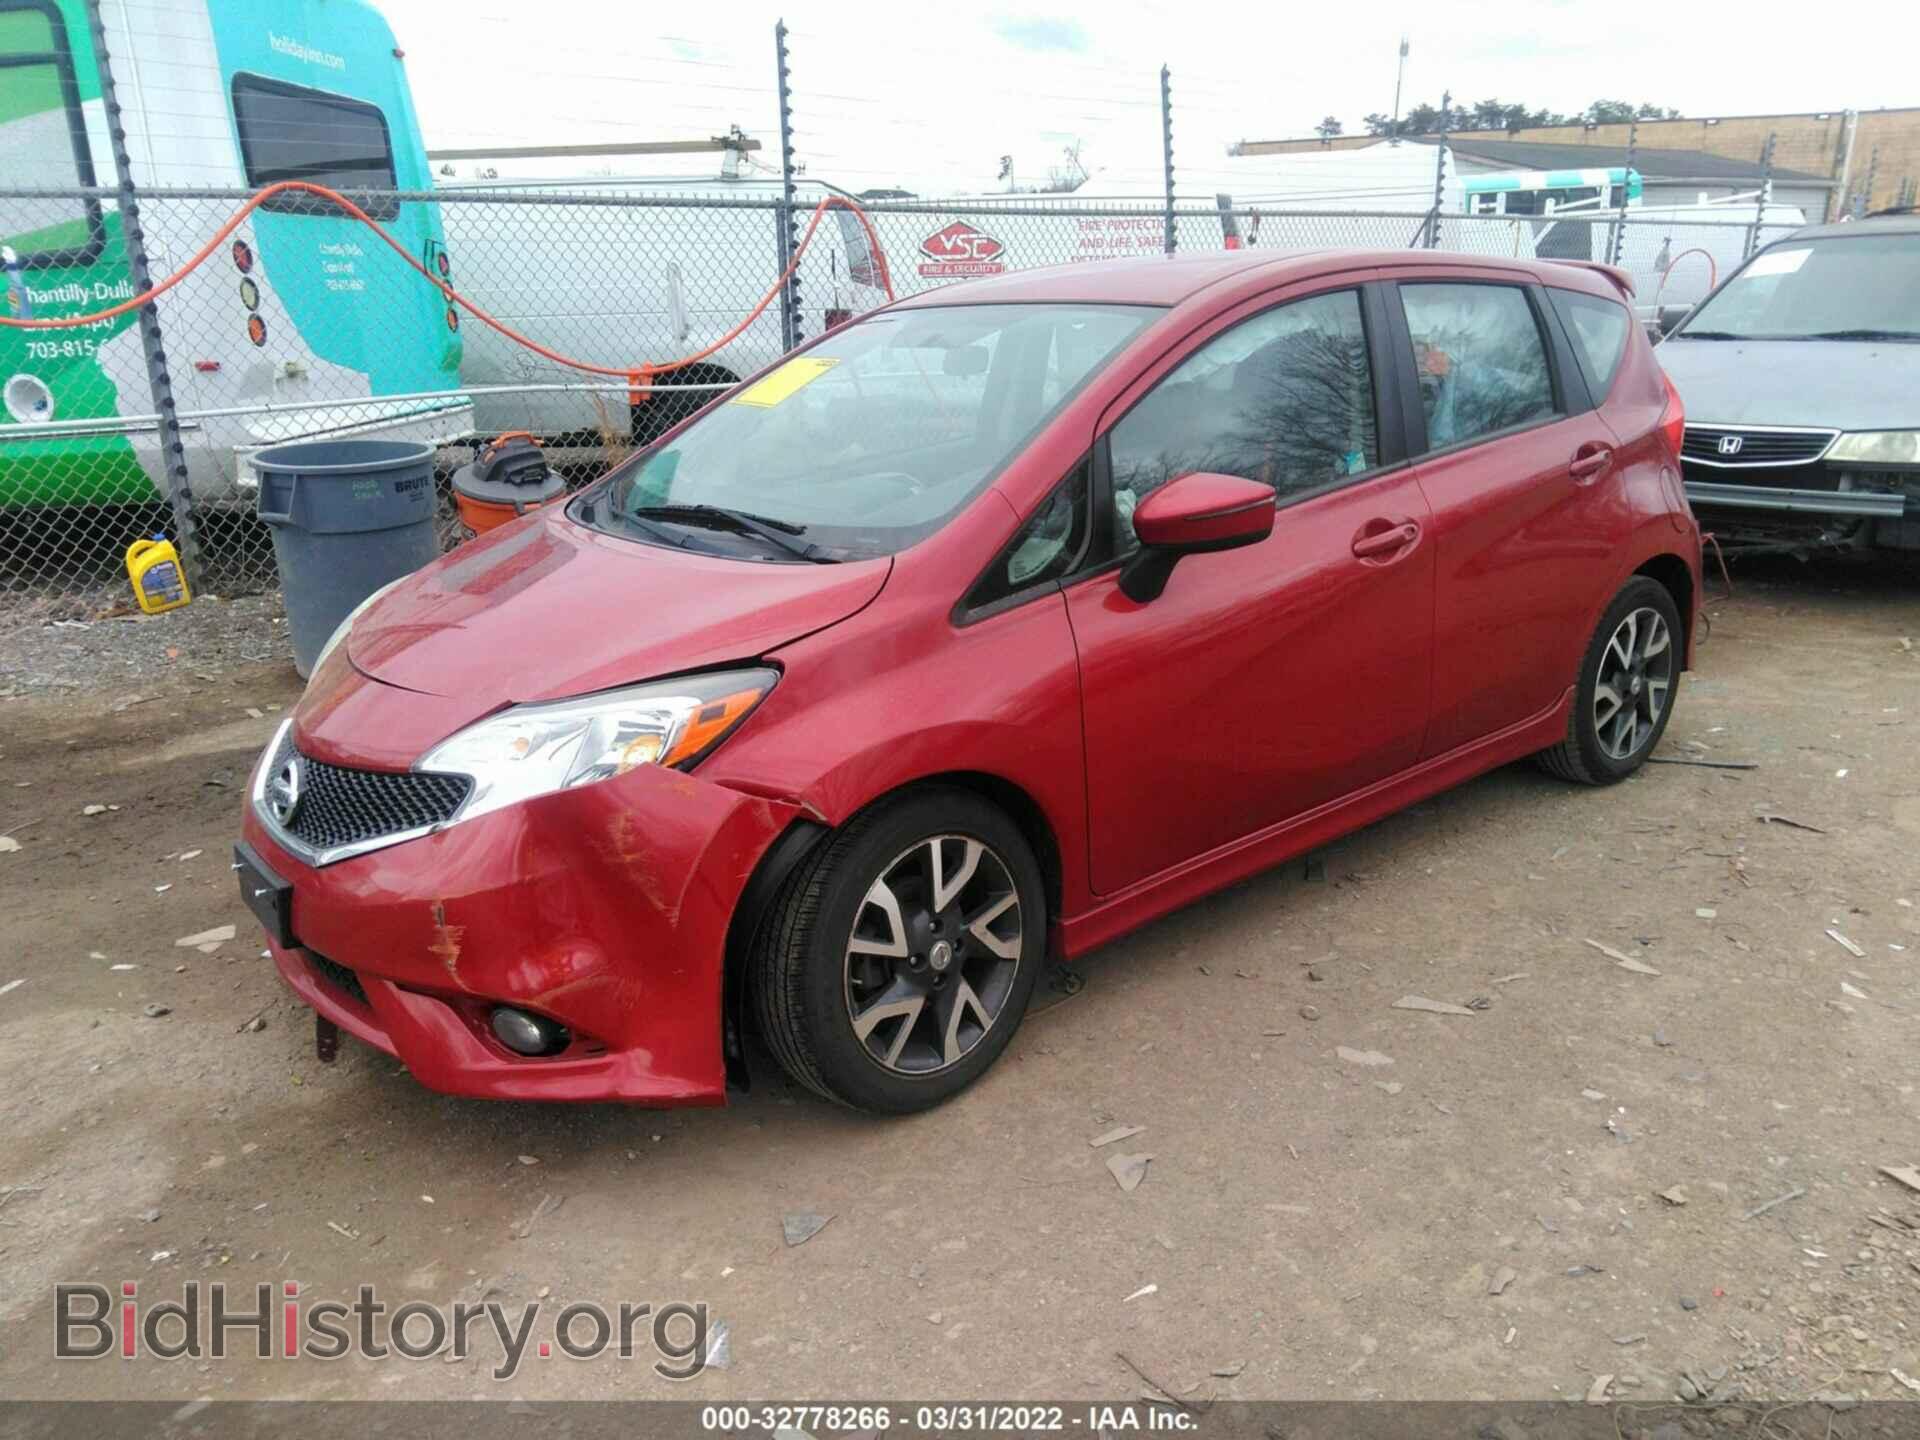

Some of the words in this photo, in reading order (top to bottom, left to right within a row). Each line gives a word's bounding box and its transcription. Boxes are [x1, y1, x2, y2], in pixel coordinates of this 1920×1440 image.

[940, 233, 993, 259] VSC
[1079, 238, 1103, 248] AND
[1136, 236, 1165, 248] SAFE
[953, 264, 997, 274] SECURITY
[26, 280, 134, 305] hantilly-Dull
[25, 339, 108, 359] 703-815-
[395, 476, 429, 493] BRUTE
